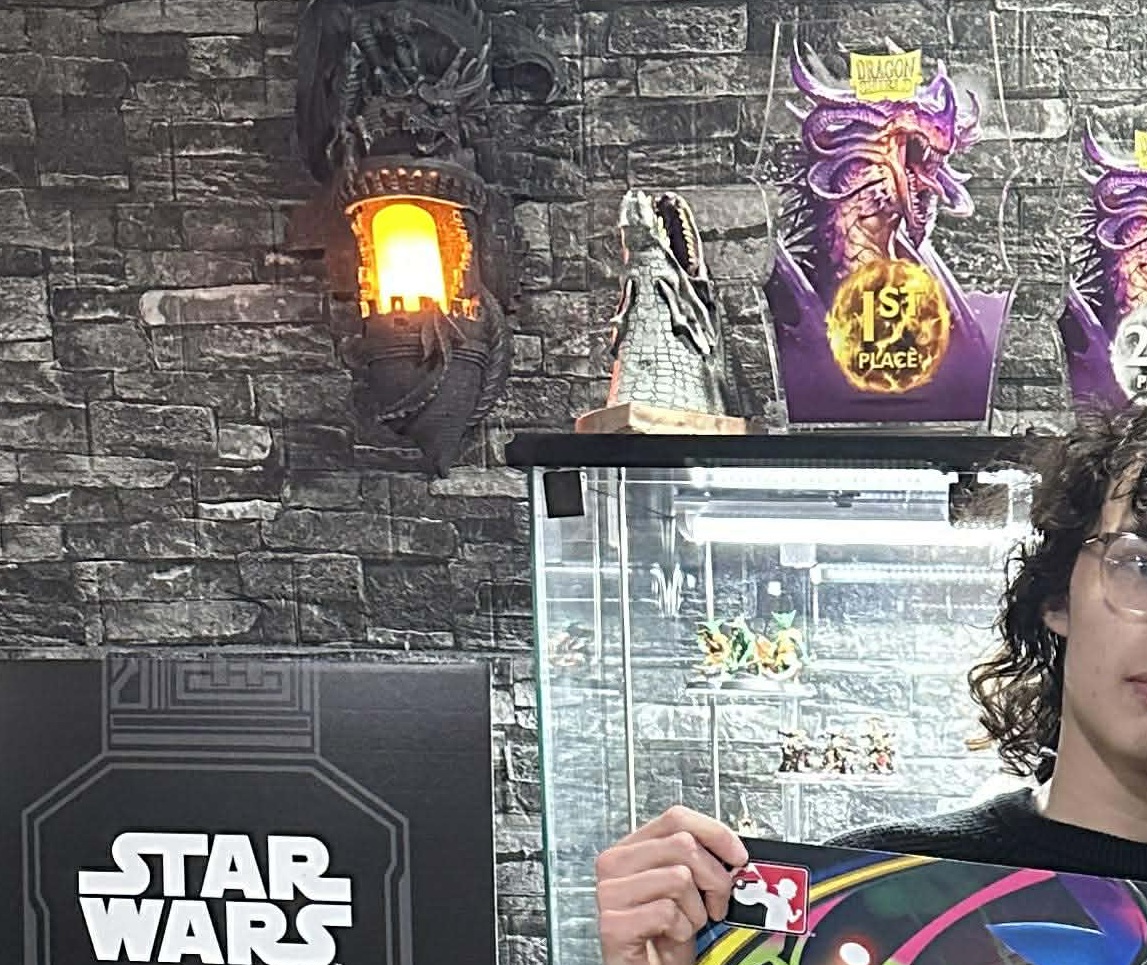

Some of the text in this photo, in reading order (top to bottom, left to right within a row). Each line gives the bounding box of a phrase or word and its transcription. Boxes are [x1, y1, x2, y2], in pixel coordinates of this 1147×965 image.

[856, 57, 916, 80] DRAGON
[863, 285, 926, 342] 1ST
[858, 350, 919, 370] PLACE
[78, 831, 352, 902] STAR
